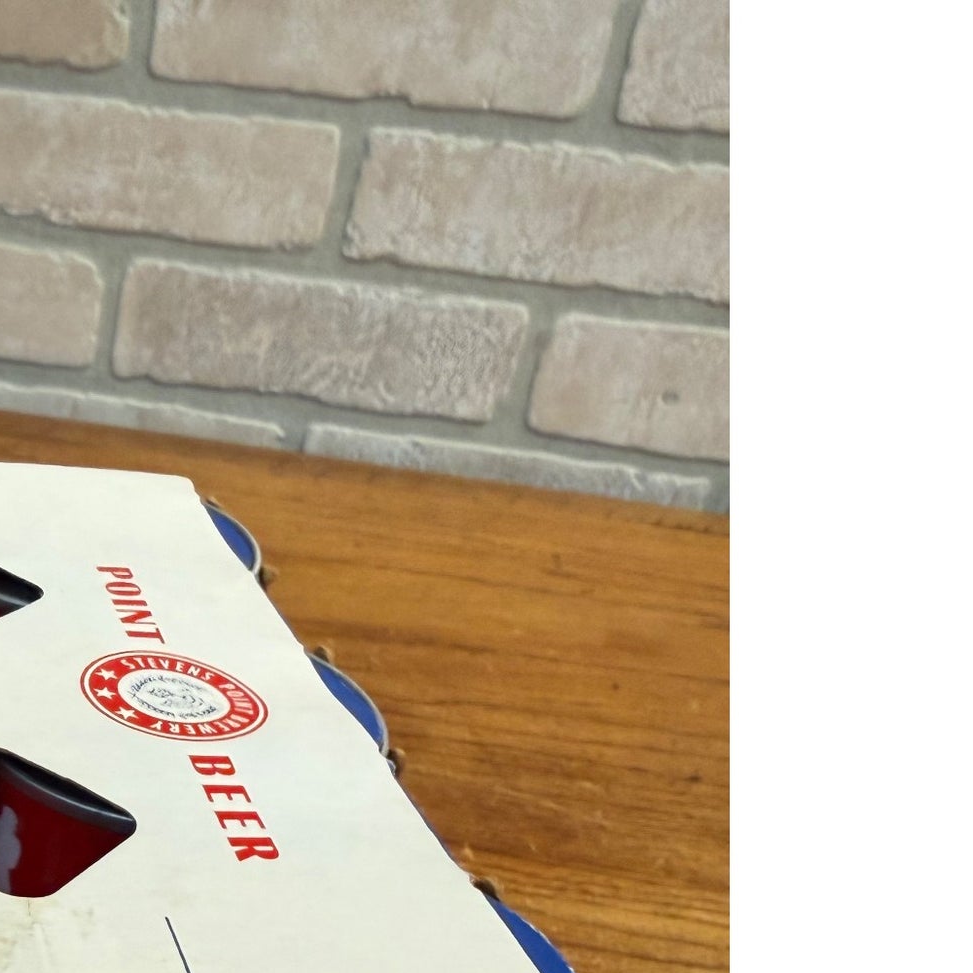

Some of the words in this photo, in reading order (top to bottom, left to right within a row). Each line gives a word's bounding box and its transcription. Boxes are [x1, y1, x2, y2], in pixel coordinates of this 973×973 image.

[96, 566, 166, 645] POINT
[120, 657, 215, 683] STEVENS
[218, 682, 254, 717] POINT
[149, 713, 255, 736] BREWERY
[188, 755, 280, 862] BEER
